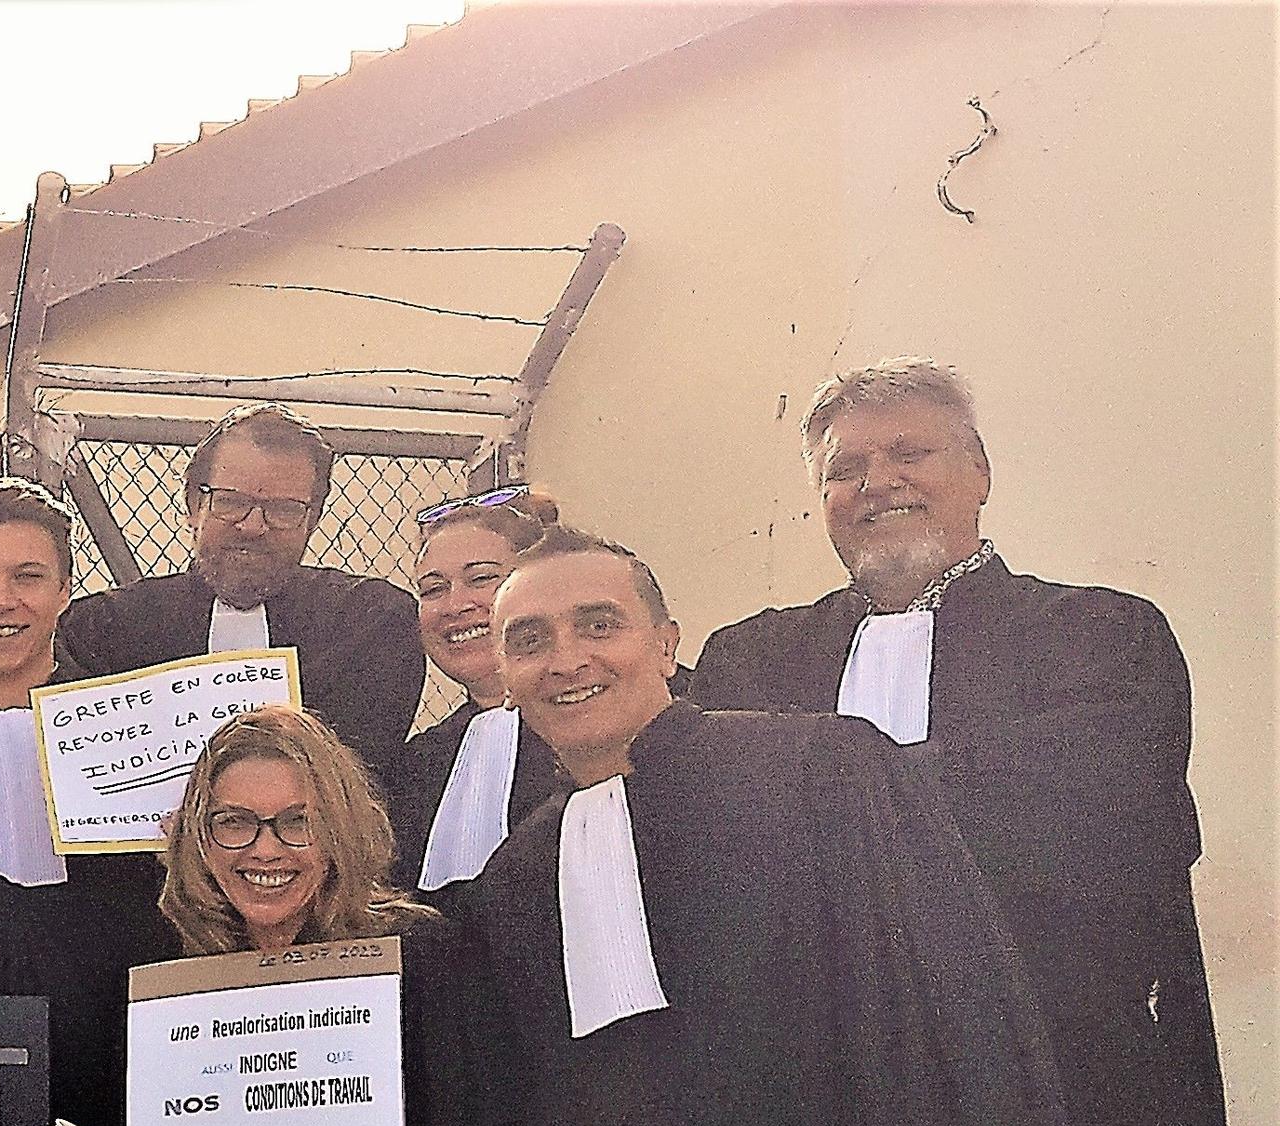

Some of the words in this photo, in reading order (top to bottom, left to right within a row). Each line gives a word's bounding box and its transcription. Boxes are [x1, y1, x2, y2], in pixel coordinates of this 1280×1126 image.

[54, 690, 154, 727] GREFFE
[172, 678, 200, 694] EN
[213, 665, 283, 685] COLÈRE
[58, 724, 152, 755] REVOYEZ
[175, 712, 198, 728] LA
[170, 1024, 200, 1042] une
[212, 1012, 304, 1038] Revalorisation
[308, 1006, 371, 1028] indiciaire
[201, 1063, 234, 1076] AUSSI
[239, 1050, 298, 1074] INDIGNE
[326, 1050, 354, 1064] QUE
[164, 1094, 220, 1117] NOS
[246, 1082, 310, 1112] CONDITIONS
[312, 1080, 326, 1106] DE
[328, 1076, 373, 1104] TRAVAIL
